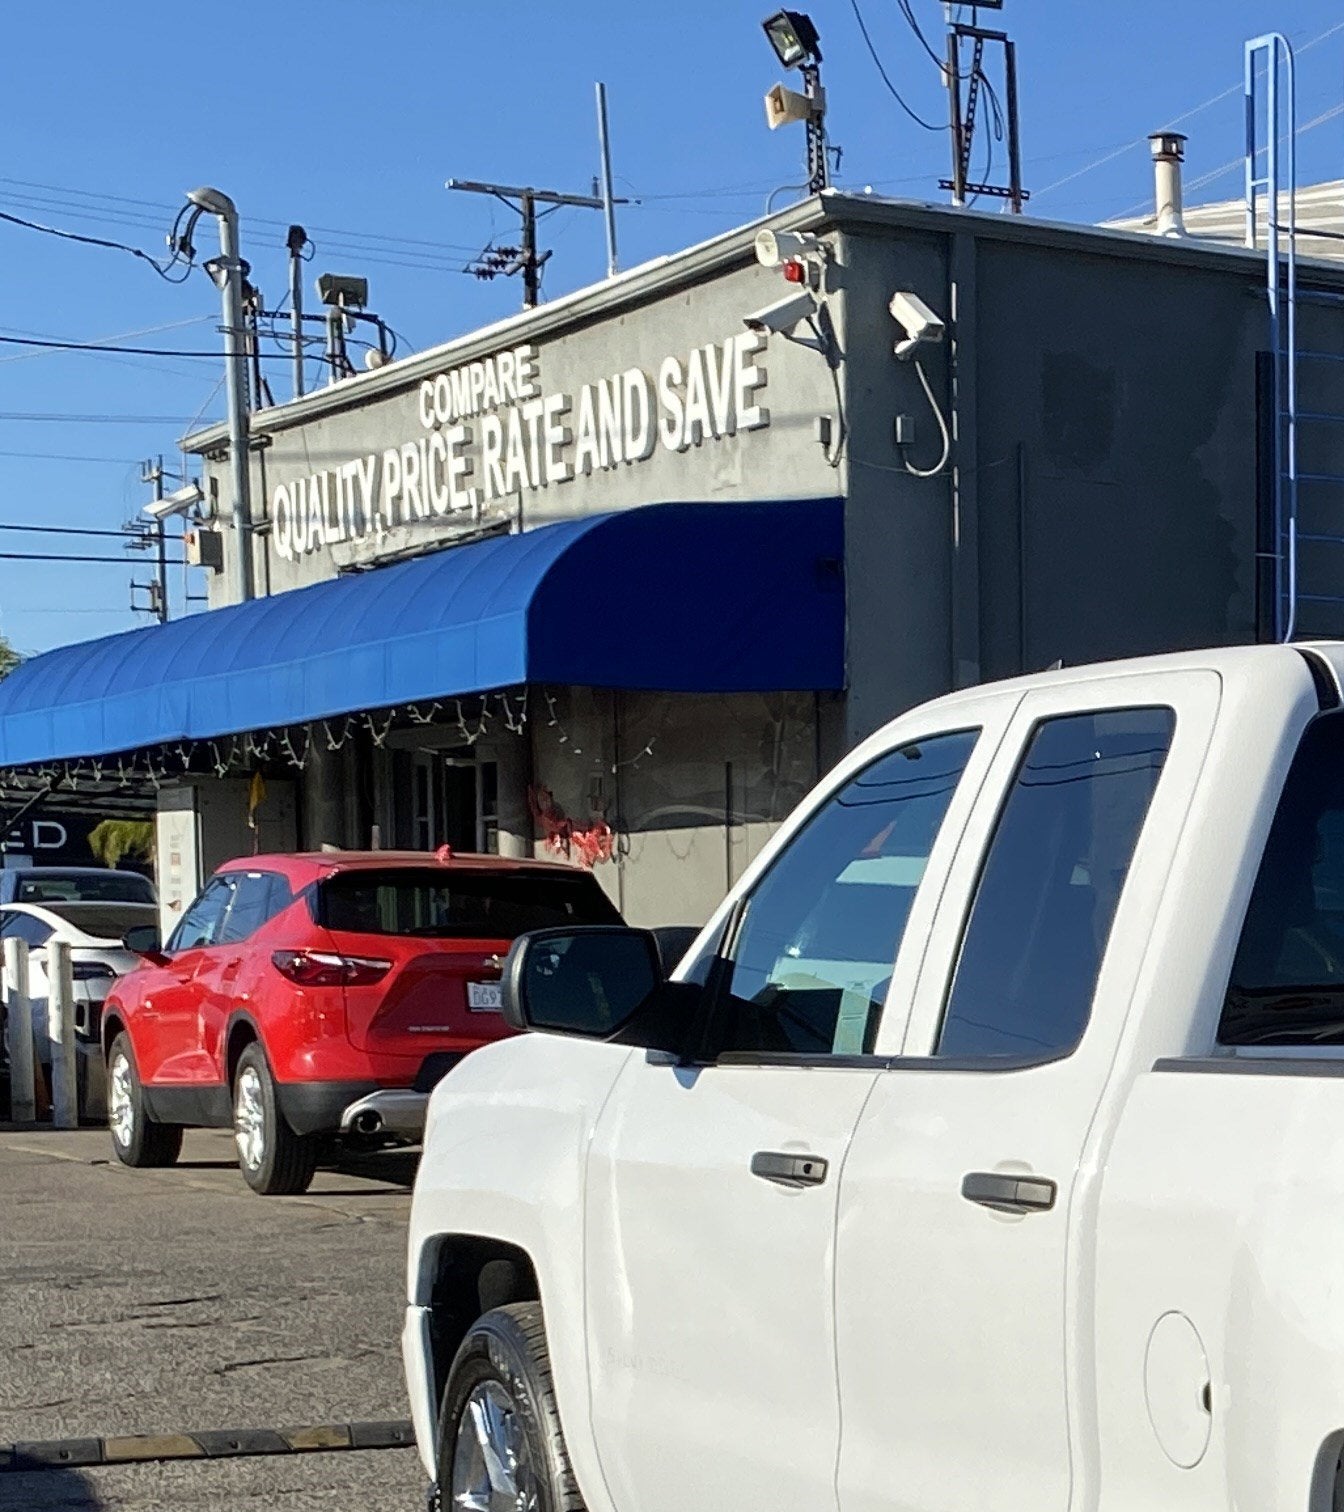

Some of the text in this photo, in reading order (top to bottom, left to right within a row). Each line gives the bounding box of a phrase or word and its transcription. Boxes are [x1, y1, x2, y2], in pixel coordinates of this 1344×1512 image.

[382, 425, 477, 526] PRICE,
[481, 392, 571, 500] RATE
[574, 366, 655, 475] AND
[658, 330, 767, 452] SAVE
[419, 345, 540, 429] COMPARE
